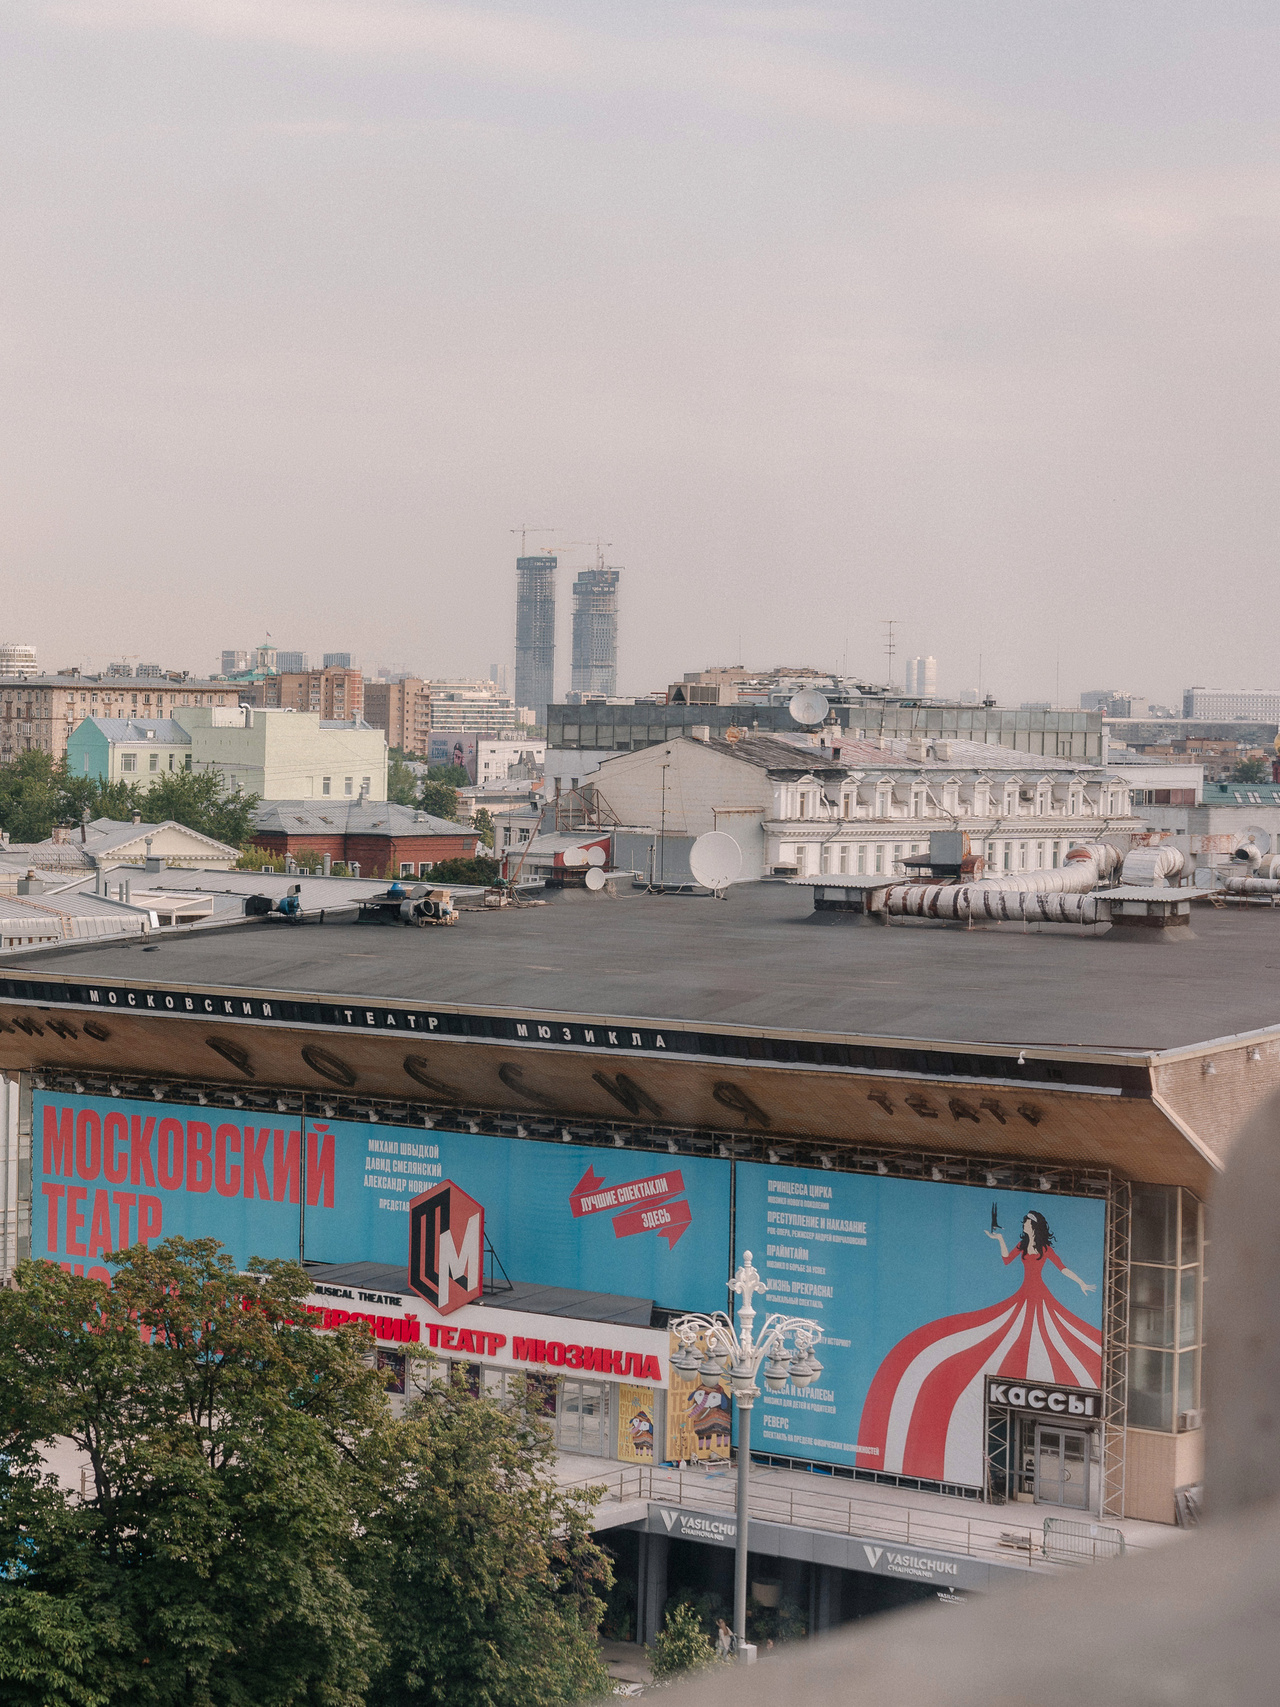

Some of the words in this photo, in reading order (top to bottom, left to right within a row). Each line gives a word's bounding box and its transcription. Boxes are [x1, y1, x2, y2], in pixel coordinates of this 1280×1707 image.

[89, 989, 272, 1017] МОСКОВСКИЙ
[344, 1009, 439, 1031] ТЕАТР
[516, 1023, 666, 1048] МЮЗИКЛА
[41, 1104, 336, 1209] МОСКОВСКИЙ
[368, 1139, 399, 1155] МИХАИЛ
[400, 1142, 439, 1159] ШВЫДКОЙ
[365, 1156, 391, 1173] ДАВИД
[392, 1159, 442, 1177] СМЕЛЯНСКИЙ
[363, 1174, 407, 1192] АЛЕКСАНДР
[408, 1179, 438, 1194] НОВИК
[767, 1179, 809, 1196] ПРИНЦЕССА
[809, 1184, 833, 1199] ЦИРКА
[580, 1190, 618, 1212] ЛУЧШИЕ
[616, 1177, 669, 1203] СПЕКТАКЛИ
[379, 1198, 410, 1212] ПРЕДСТАВ
[41, 1182, 163, 1259] ТЕАТР
[641, 1208, 671, 1228] ЗДЕСЬ
[767, 1210, 820, 1229] ПРЕСТУПЛЕНИЕ
[820, 1217, 826, 1230] И
[826, 1217, 867, 1234] НАКАЗАНИЕ
[766, 1244, 809, 1261] ПРАЙМТАЙМ
[766, 1278, 791, 1293] ЖИЗНЬ
[791, 1281, 834, 1298] ПРЕКРАСНА!
[357, 1291, 403, 1307] THEATRE
[424, 1322, 507, 1357] ТЕАТР
[512, 1335, 662, 1381] МЮЗИКЛА
[763, 1414, 790, 1430] РЕВЕРС
[680, 1515, 737, 1536] VASILCHU
[886, 1552, 958, 1575] VASILCHUKI
